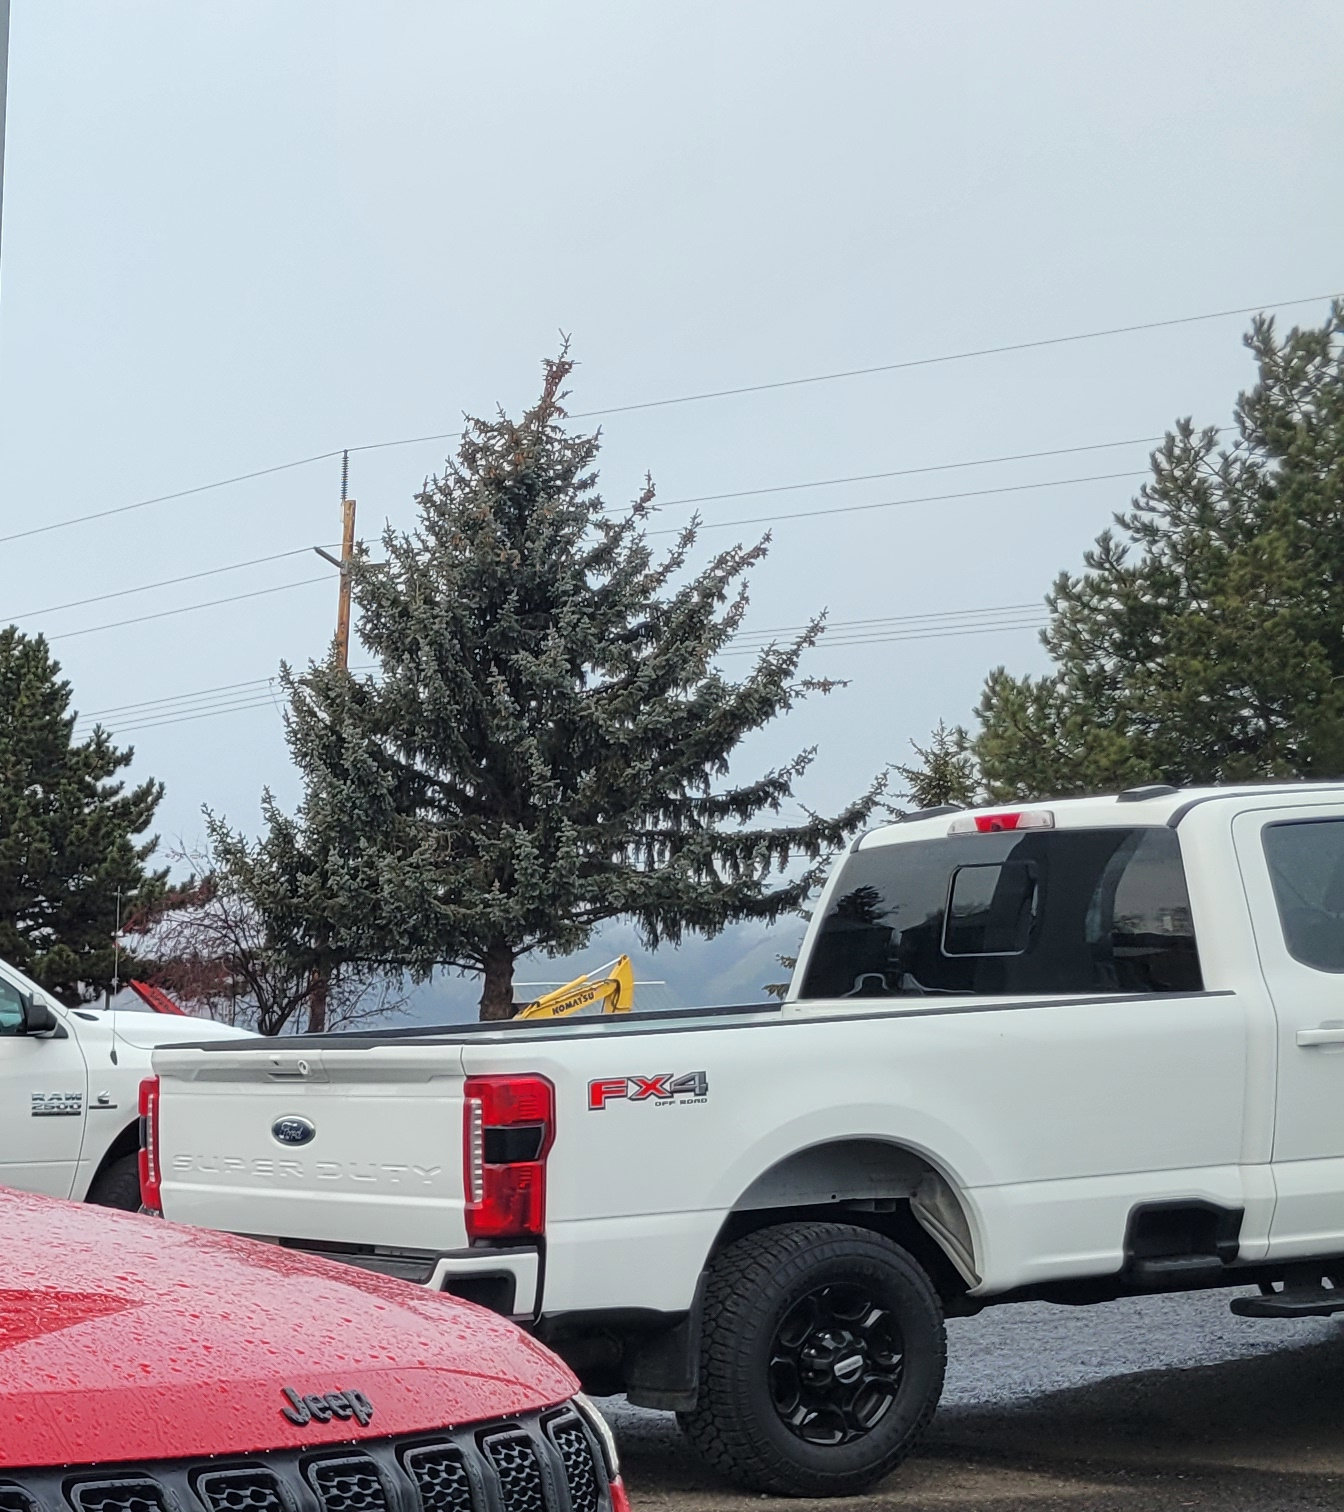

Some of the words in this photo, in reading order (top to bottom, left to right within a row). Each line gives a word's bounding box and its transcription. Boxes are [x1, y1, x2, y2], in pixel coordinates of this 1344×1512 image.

[551, 991, 595, 1016] KOMATSU
[31, 1092, 83, 1102] RAM
[587, 1070, 709, 1111] FX4
[31, 1102, 82, 1111] 2500
[679, 1098, 708, 1106] ROAD
[278, 1121, 304, 1140] Ford
[172, 1154, 305, 1178] SUPER
[315, 1161, 442, 1184] DUTY
[280, 1387, 374, 1428] Jeep
